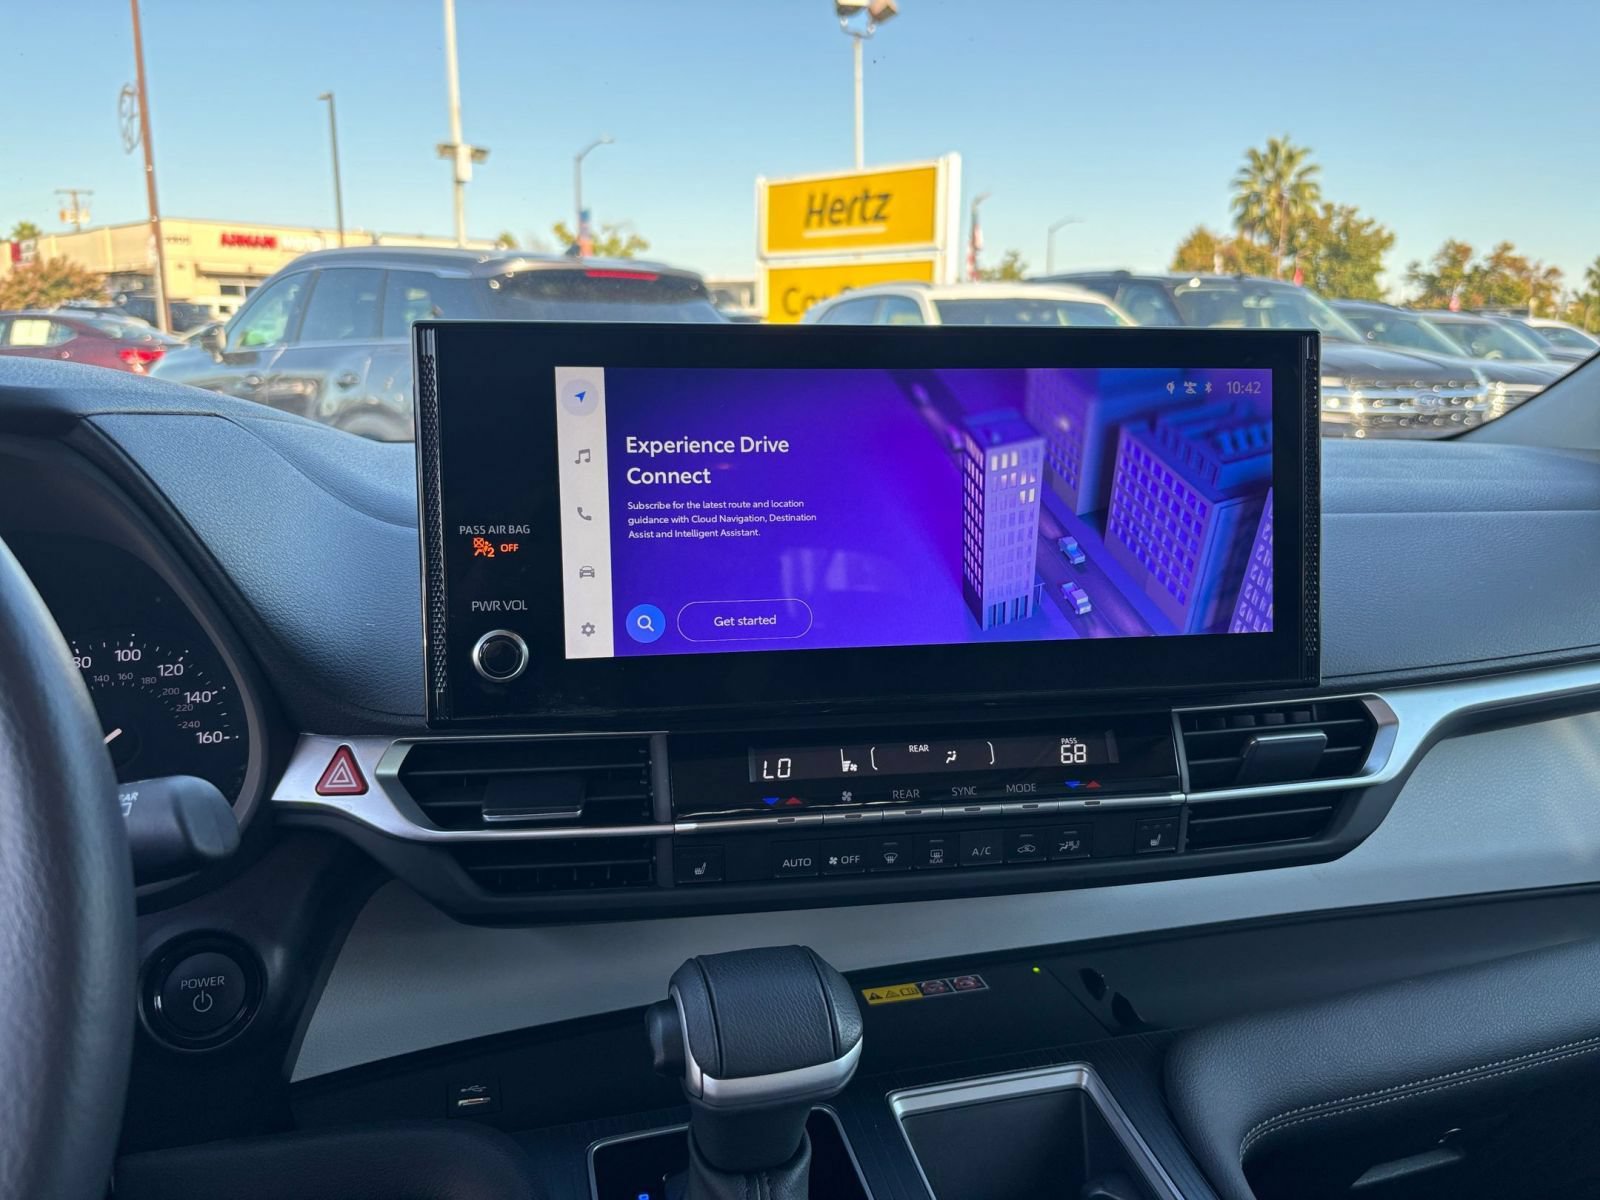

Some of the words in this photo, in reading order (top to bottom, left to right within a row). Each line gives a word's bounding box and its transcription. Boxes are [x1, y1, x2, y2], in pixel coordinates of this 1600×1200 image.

[804, 188, 892, 229] Hertz
[1227, 381, 1261, 394] 10:42
[626, 436, 735, 457] Experience
[740, 436, 790, 453] Drive
[626, 467, 711, 485] Connect
[628, 501, 671, 510] Subscribe
[672, 501, 684, 509] for
[687, 501, 700, 509] the
[753, 500, 769, 508] and
[771, 500, 804, 508] location
[628, 516, 669, 526] guidance
[671, 515, 690, 523] with
[692, 515, 717, 523] Cloud
[720, 514, 767, 524] Navigation,
[770, 513, 816, 522] Destination
[460, 525, 486, 535] PASS
[488, 525, 506, 534] AIR
[508, 525, 530, 534] BAG
[629, 530, 654, 538] Assist
[656, 530, 672, 538] and
[675, 529, 718, 539] Intelligent
[720, 528, 760, 537] Assistant.
[500, 544, 519, 552] OFF
[472, 600, 501, 612] PWR
[503, 600, 528, 611] VOL
[714, 616, 735, 627] Get
[738, 614, 777, 626] started
[114, 650, 141, 662] 100
[118, 672, 134, 680] 160
[157, 664, 184, 677] 120
[94, 674, 110, 682] 140
[141, 676, 157, 684] 180
[184, 690, 212, 703] 140
[176, 704, 193, 712] 220
[182, 720, 200, 728] 240
[196, 731, 223, 744] 160
[1061, 737, 1078, 745] PASS
[909, 744, 929, 753] REAR
[1060, 744, 1087, 764] 68
[763, 758, 792, 779] LO
[952, 786, 977, 797] SYNC
[1006, 783, 1037, 793] MODE
[119, 792, 139, 802] EAR
[892, 789, 920, 800] REAR
[972, 847, 991, 856] A/C
[782, 858, 811, 868] AUTO
[841, 856, 860, 864] OFF
[180, 976, 224, 990] POWER
